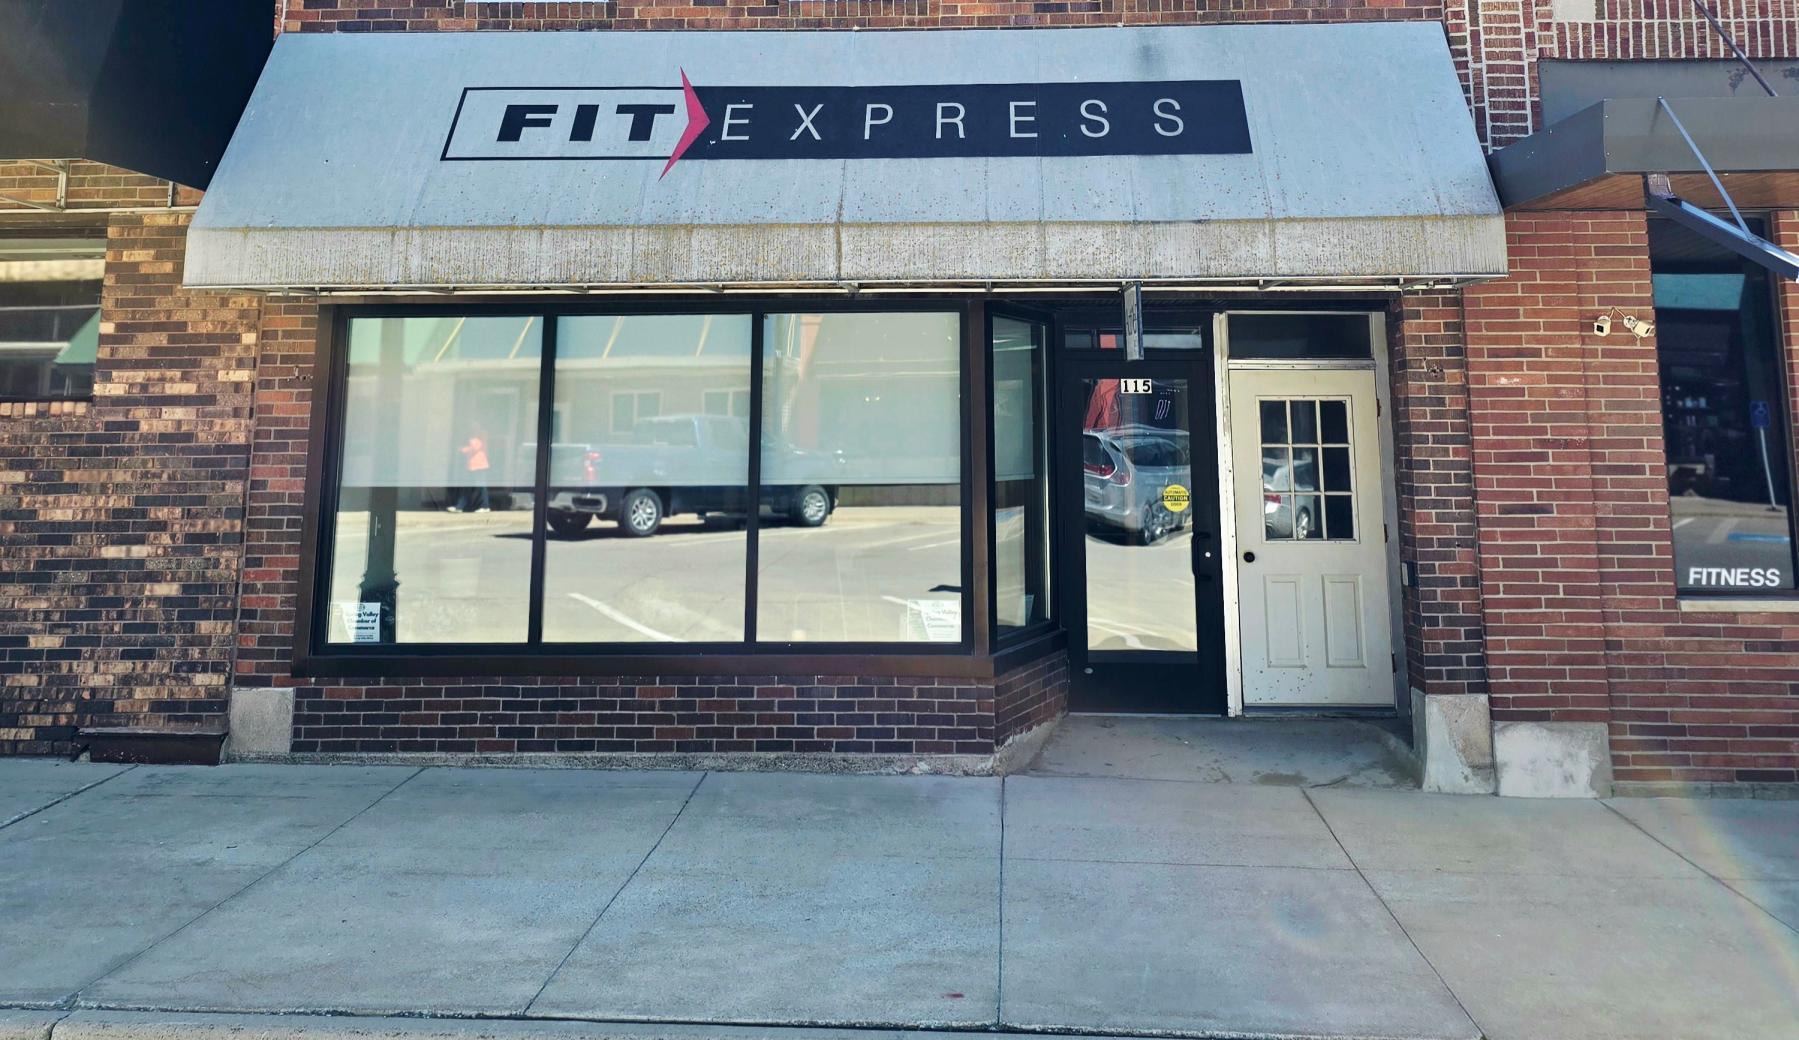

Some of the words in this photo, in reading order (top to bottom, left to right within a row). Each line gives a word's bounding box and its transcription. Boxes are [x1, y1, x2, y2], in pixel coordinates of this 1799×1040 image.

[496, 104, 676, 142] FIT
[721, 99, 1185, 141] EXPRESS
[1123, 380, 1151, 393] 115
[1688, 567, 1781, 587] FITNESS
